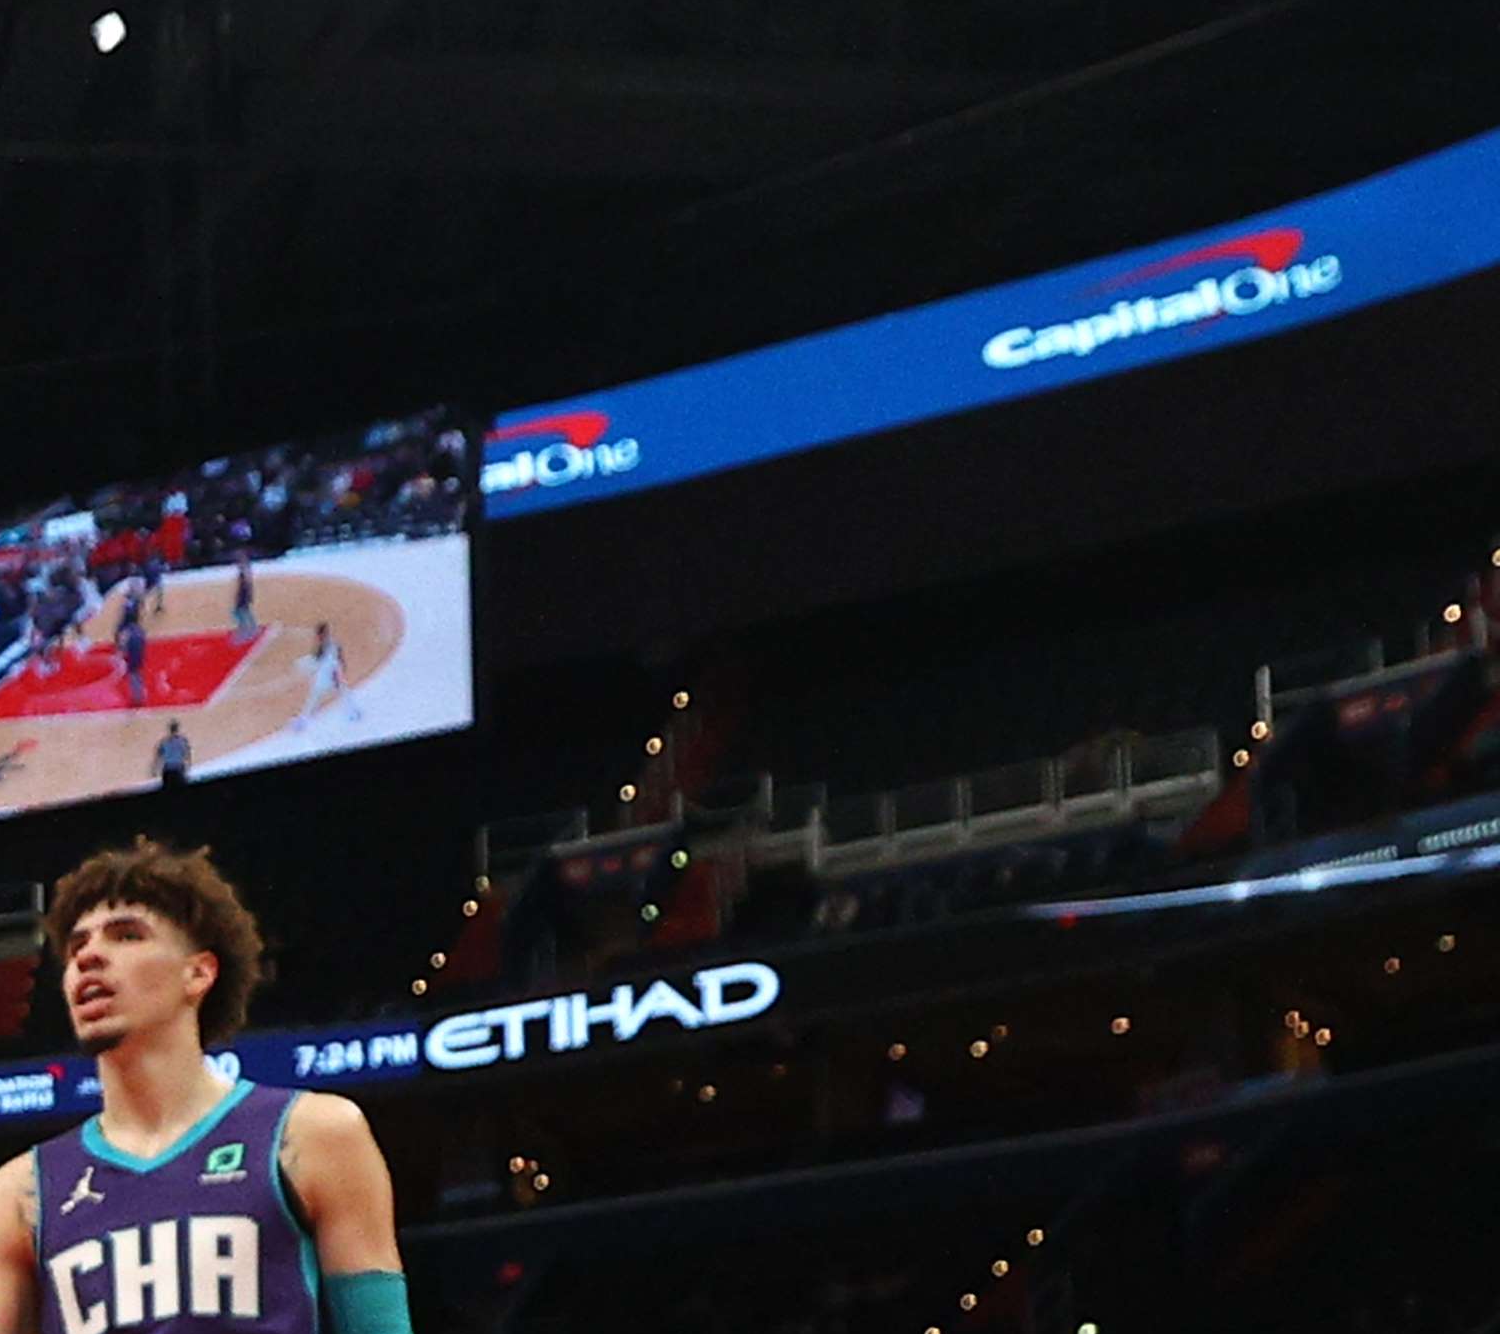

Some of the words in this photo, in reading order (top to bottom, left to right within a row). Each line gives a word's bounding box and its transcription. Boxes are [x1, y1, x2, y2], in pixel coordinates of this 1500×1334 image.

[293, 1039, 363, 1078] 7:24
[367, 1031, 419, 1070] PM
[423, 961, 781, 1070] ETIHAD
